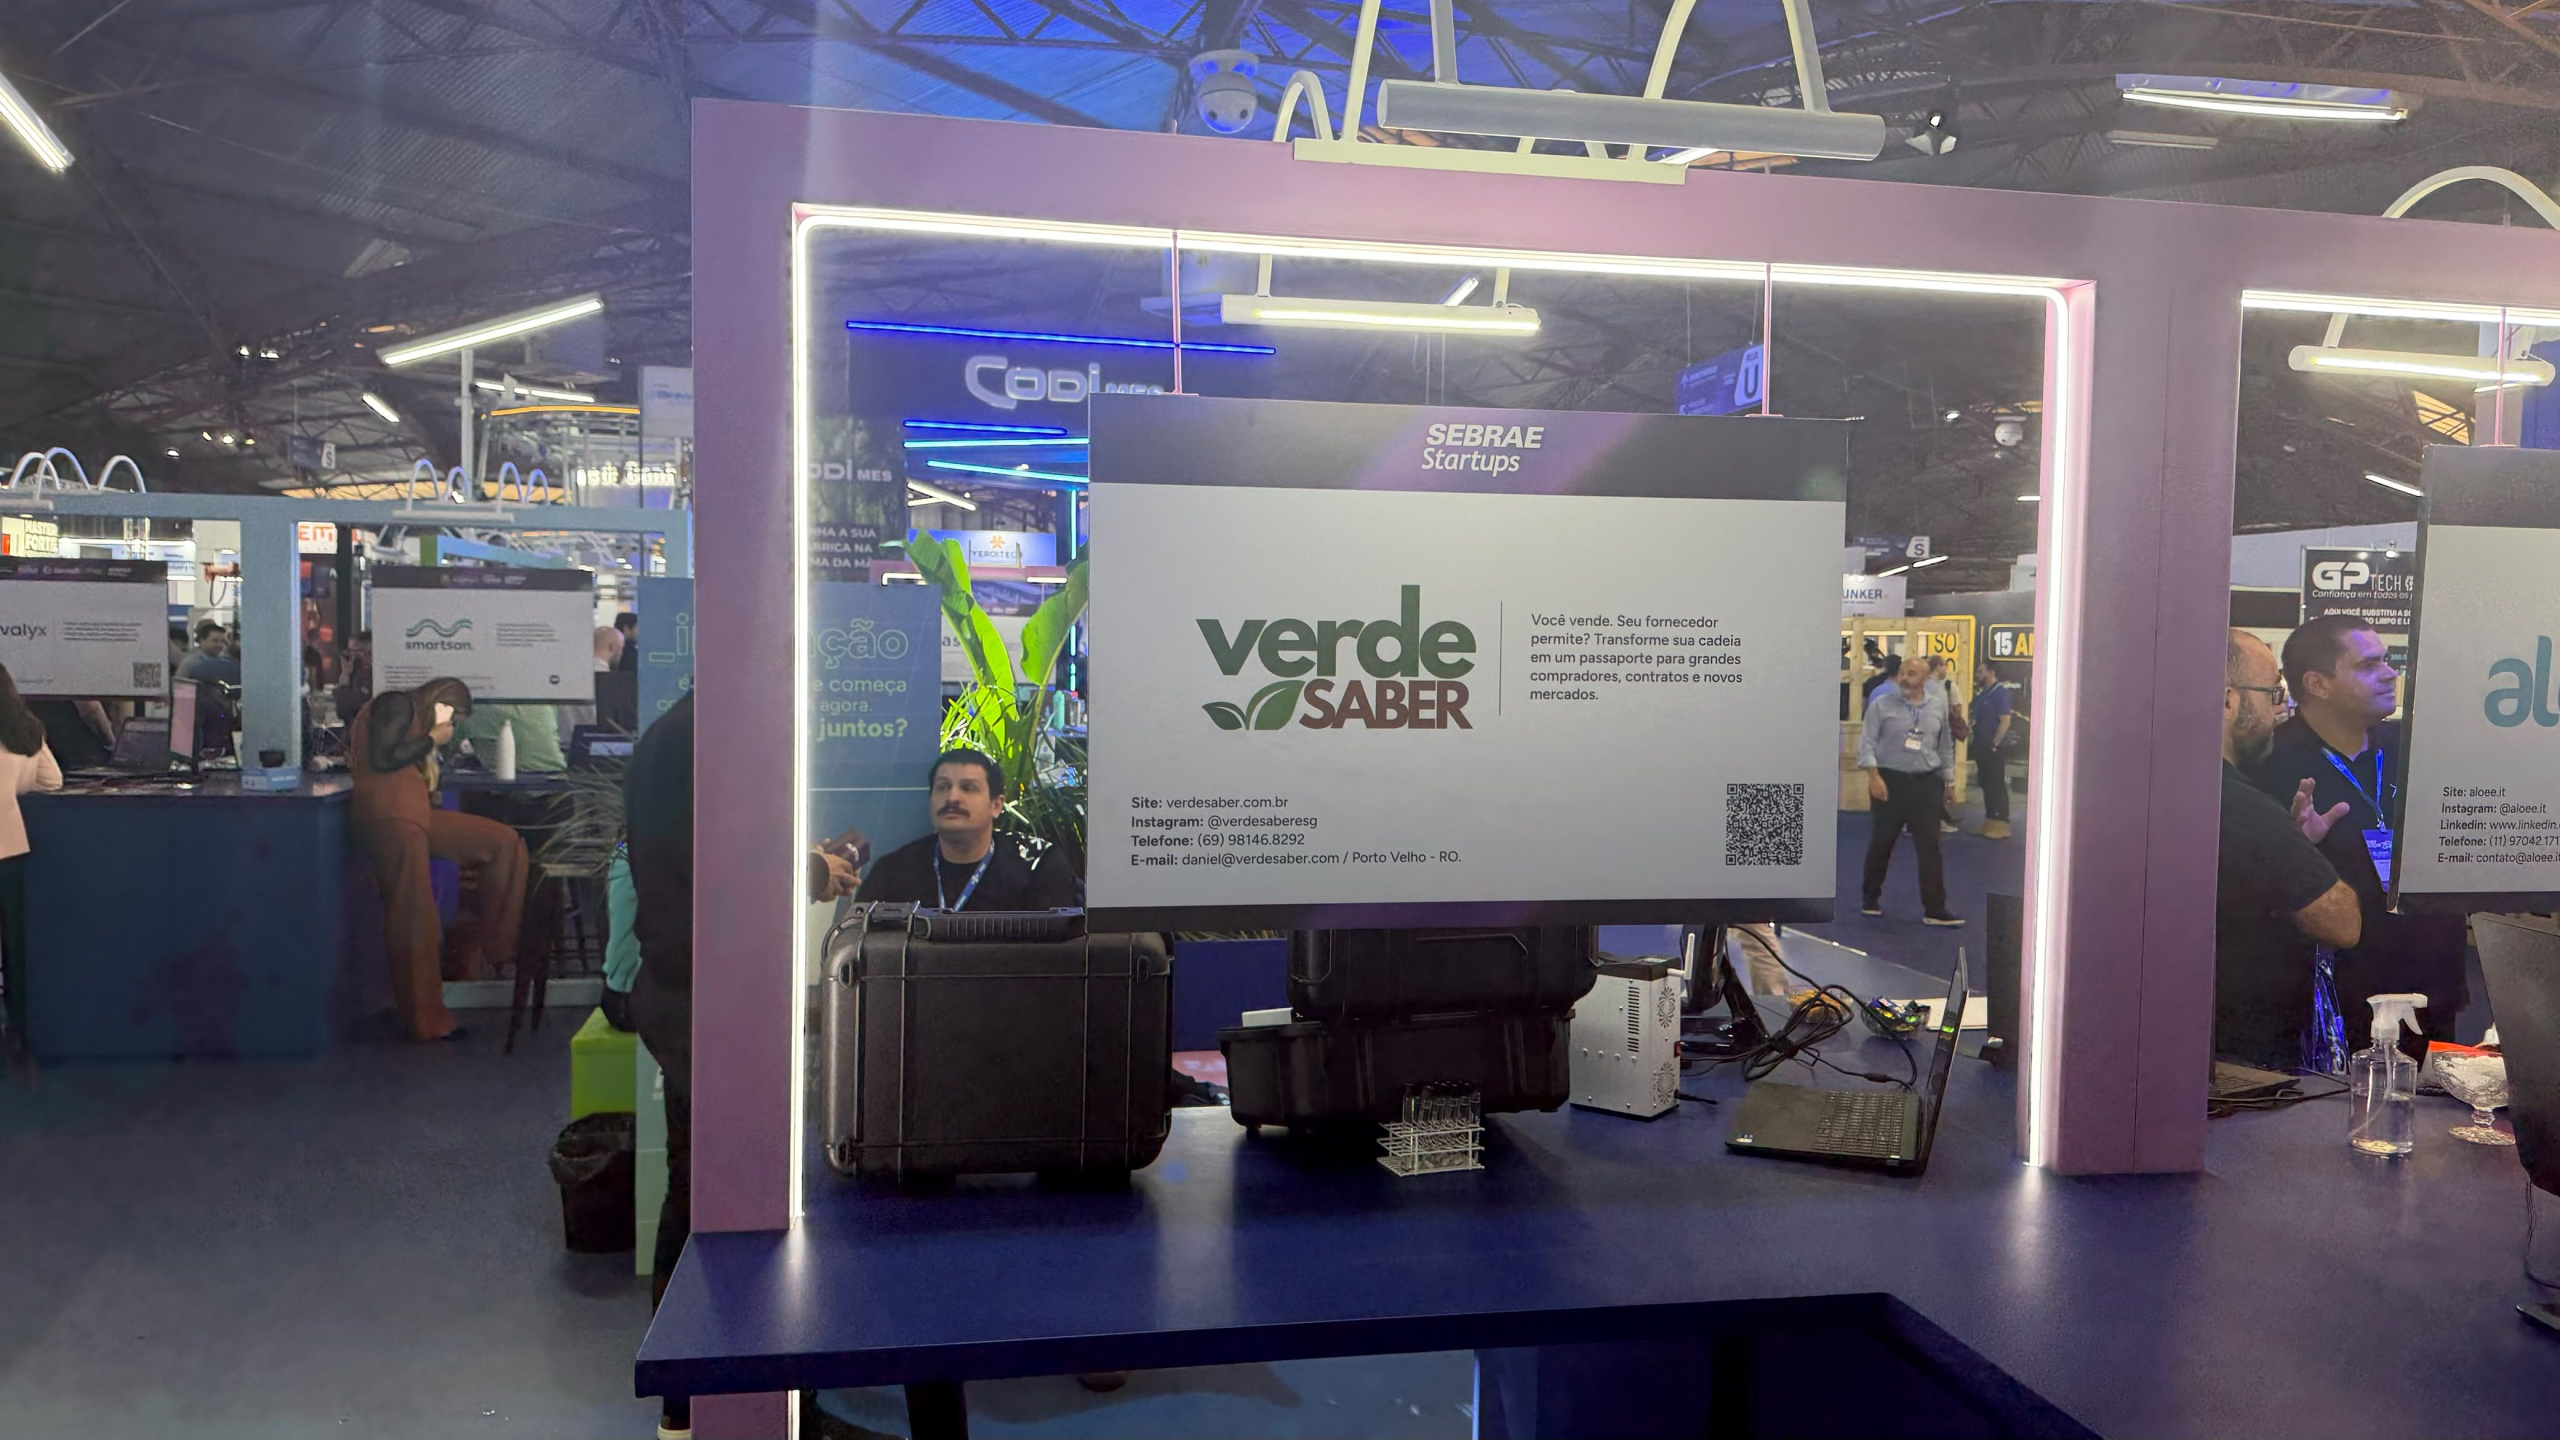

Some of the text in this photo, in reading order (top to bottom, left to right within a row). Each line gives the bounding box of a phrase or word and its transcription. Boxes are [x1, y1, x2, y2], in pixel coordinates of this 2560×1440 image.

[1743, 365, 1759, 399] U
[1426, 423, 1545, 449] SEBRAE
[1421, 447, 1521, 477] Startups
[856, 469, 892, 482] MES
[850, 528, 877, 539] SUA
[854, 543, 873, 553] NA
[1914, 544, 1925, 556] S
[832, 557, 851, 568] DA
[2312, 561, 2402, 591] GP TECH
[2312, 589, 2356, 599] Confiança
[2357, 591, 2372, 599] em
[2373, 590, 2398, 599] todos
[2341, 607, 2361, 616] VOCÊ
[2361, 608, 2397, 617] SUBSTITUI
[1531, 613, 1719, 628] Você vende. Seu fornecedor
[2375, 617, 2396, 625] LIMPO
[1195, 584, 1477, 679] verde
[1530, 633, 1742, 647] permite? Transforme sua cadeia
[1994, 631, 2013, 656] 15
[1530, 652, 1741, 668] em um passaporte para grandes
[1530, 670, 1743, 684] compradores, contratos e novos
[829, 678, 907, 697] começa
[1530, 688, 1599, 700] mercados.
[820, 700, 873, 716] agora.
[1299, 678, 1473, 730] SABER
[817, 716, 909, 743] juntos?
[2442, 786, 2506, 797] Site: aloee.it
[1131, 796, 1289, 809] Site: verdesaber.com.br
[2441, 803, 2547, 815] Instagram: @aloee.it
[1131, 815, 1318, 830] Instagram: @verdesaberesg
[2440, 819, 2560, 830] Linkedin: www.linkedin.
[1131, 832, 1305, 847] Telefone: (69) 98146.8292
[2438, 835, 2487, 846] Telefone:
[2489, 834, 2507, 847] (11)
[1131, 853, 1178, 866] E-mail:
[1182, 853, 1340, 868] daniel@verdesaber.com
[1343, 851, 1349, 864] /
[1352, 851, 1387, 863] Porto
[1390, 850, 1427, 863] Velho
[1439, 850, 1462, 863] RO.
[2437, 852, 2474, 863] E-mail:
